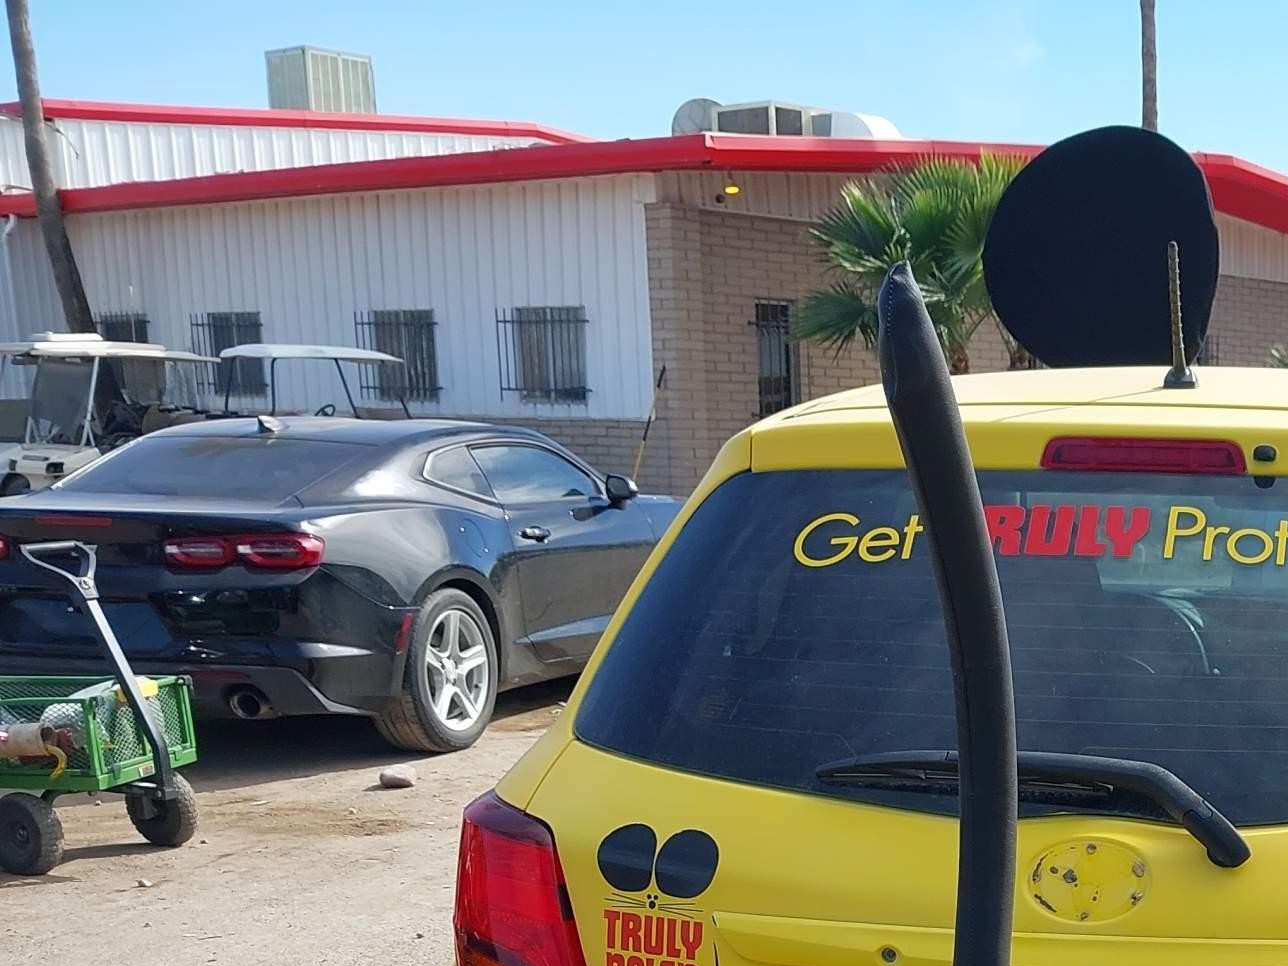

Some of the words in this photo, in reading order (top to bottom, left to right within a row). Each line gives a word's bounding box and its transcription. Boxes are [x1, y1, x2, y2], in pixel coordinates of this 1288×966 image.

[793, 512, 923, 568] Get
[984, 505, 1151, 556] RULY
[604, 910, 704, 961] TRULY
